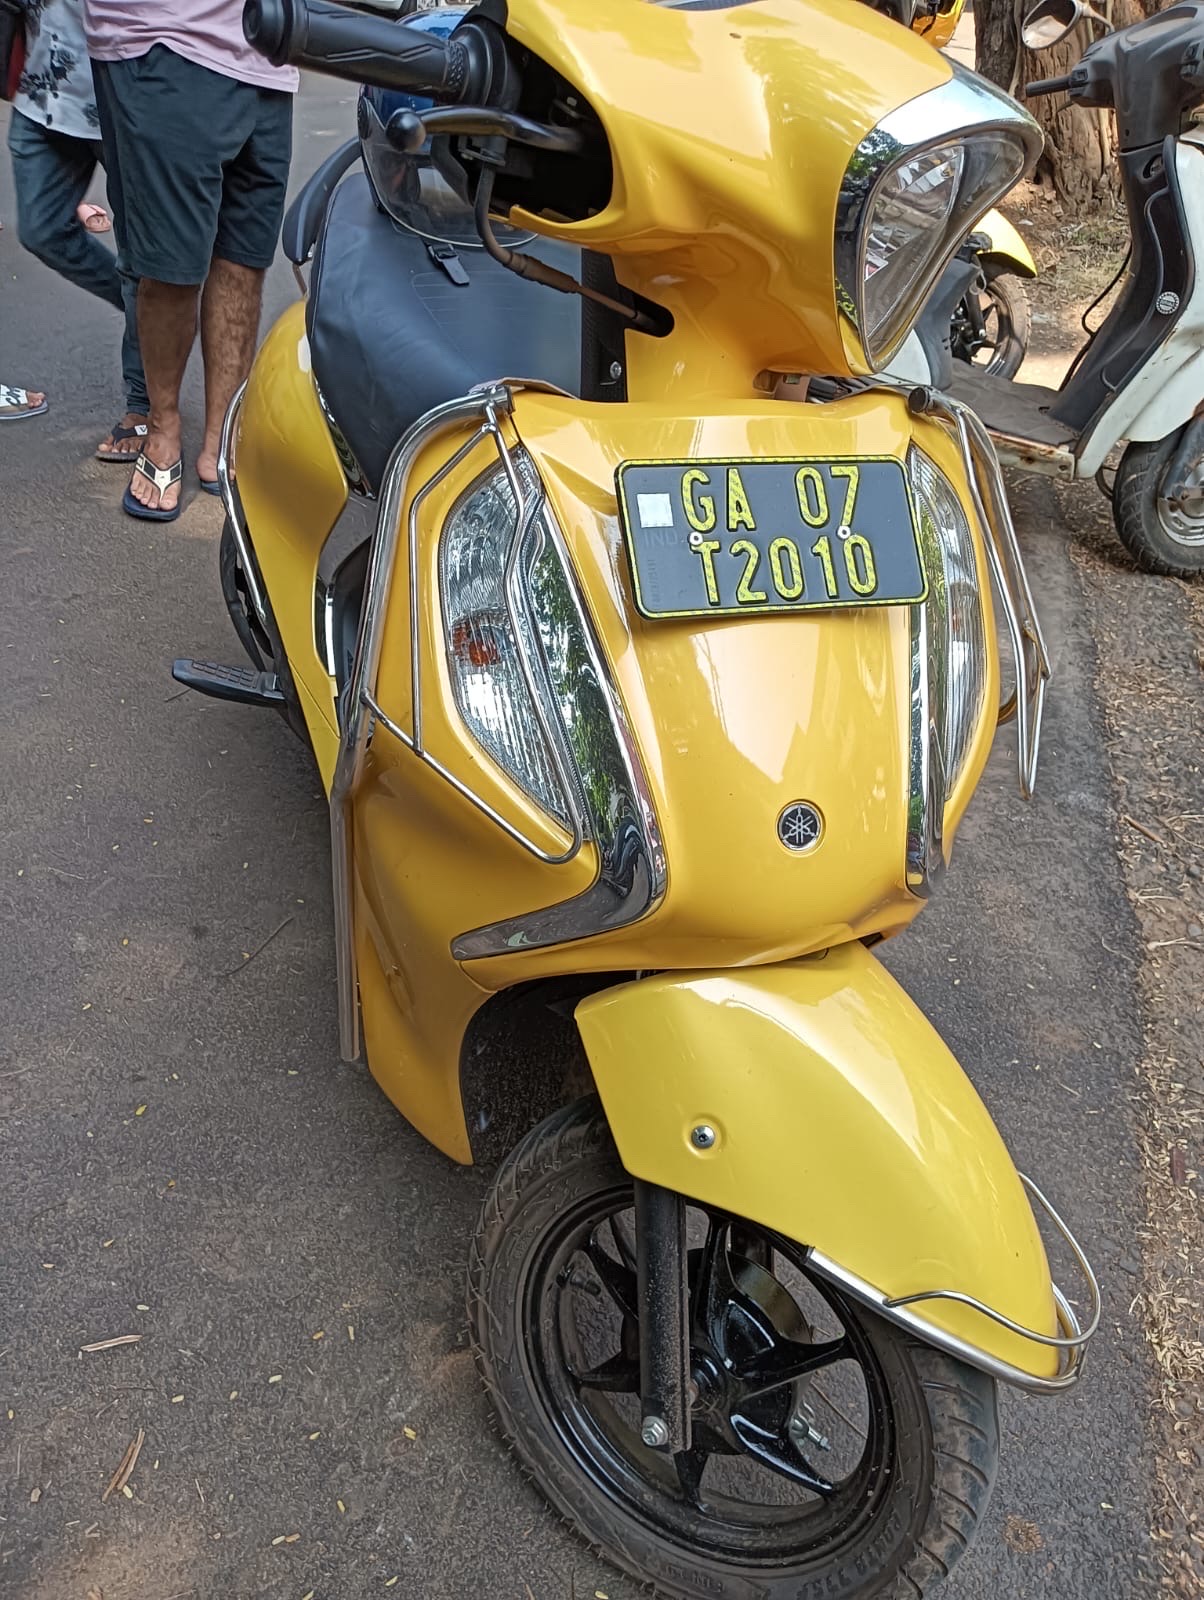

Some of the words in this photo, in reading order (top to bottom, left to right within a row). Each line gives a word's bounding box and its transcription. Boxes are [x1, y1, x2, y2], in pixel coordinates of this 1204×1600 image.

[681, 467, 756, 533] GA
[794, 465, 860, 528] 07
[690, 534, 879, 606] T2010
